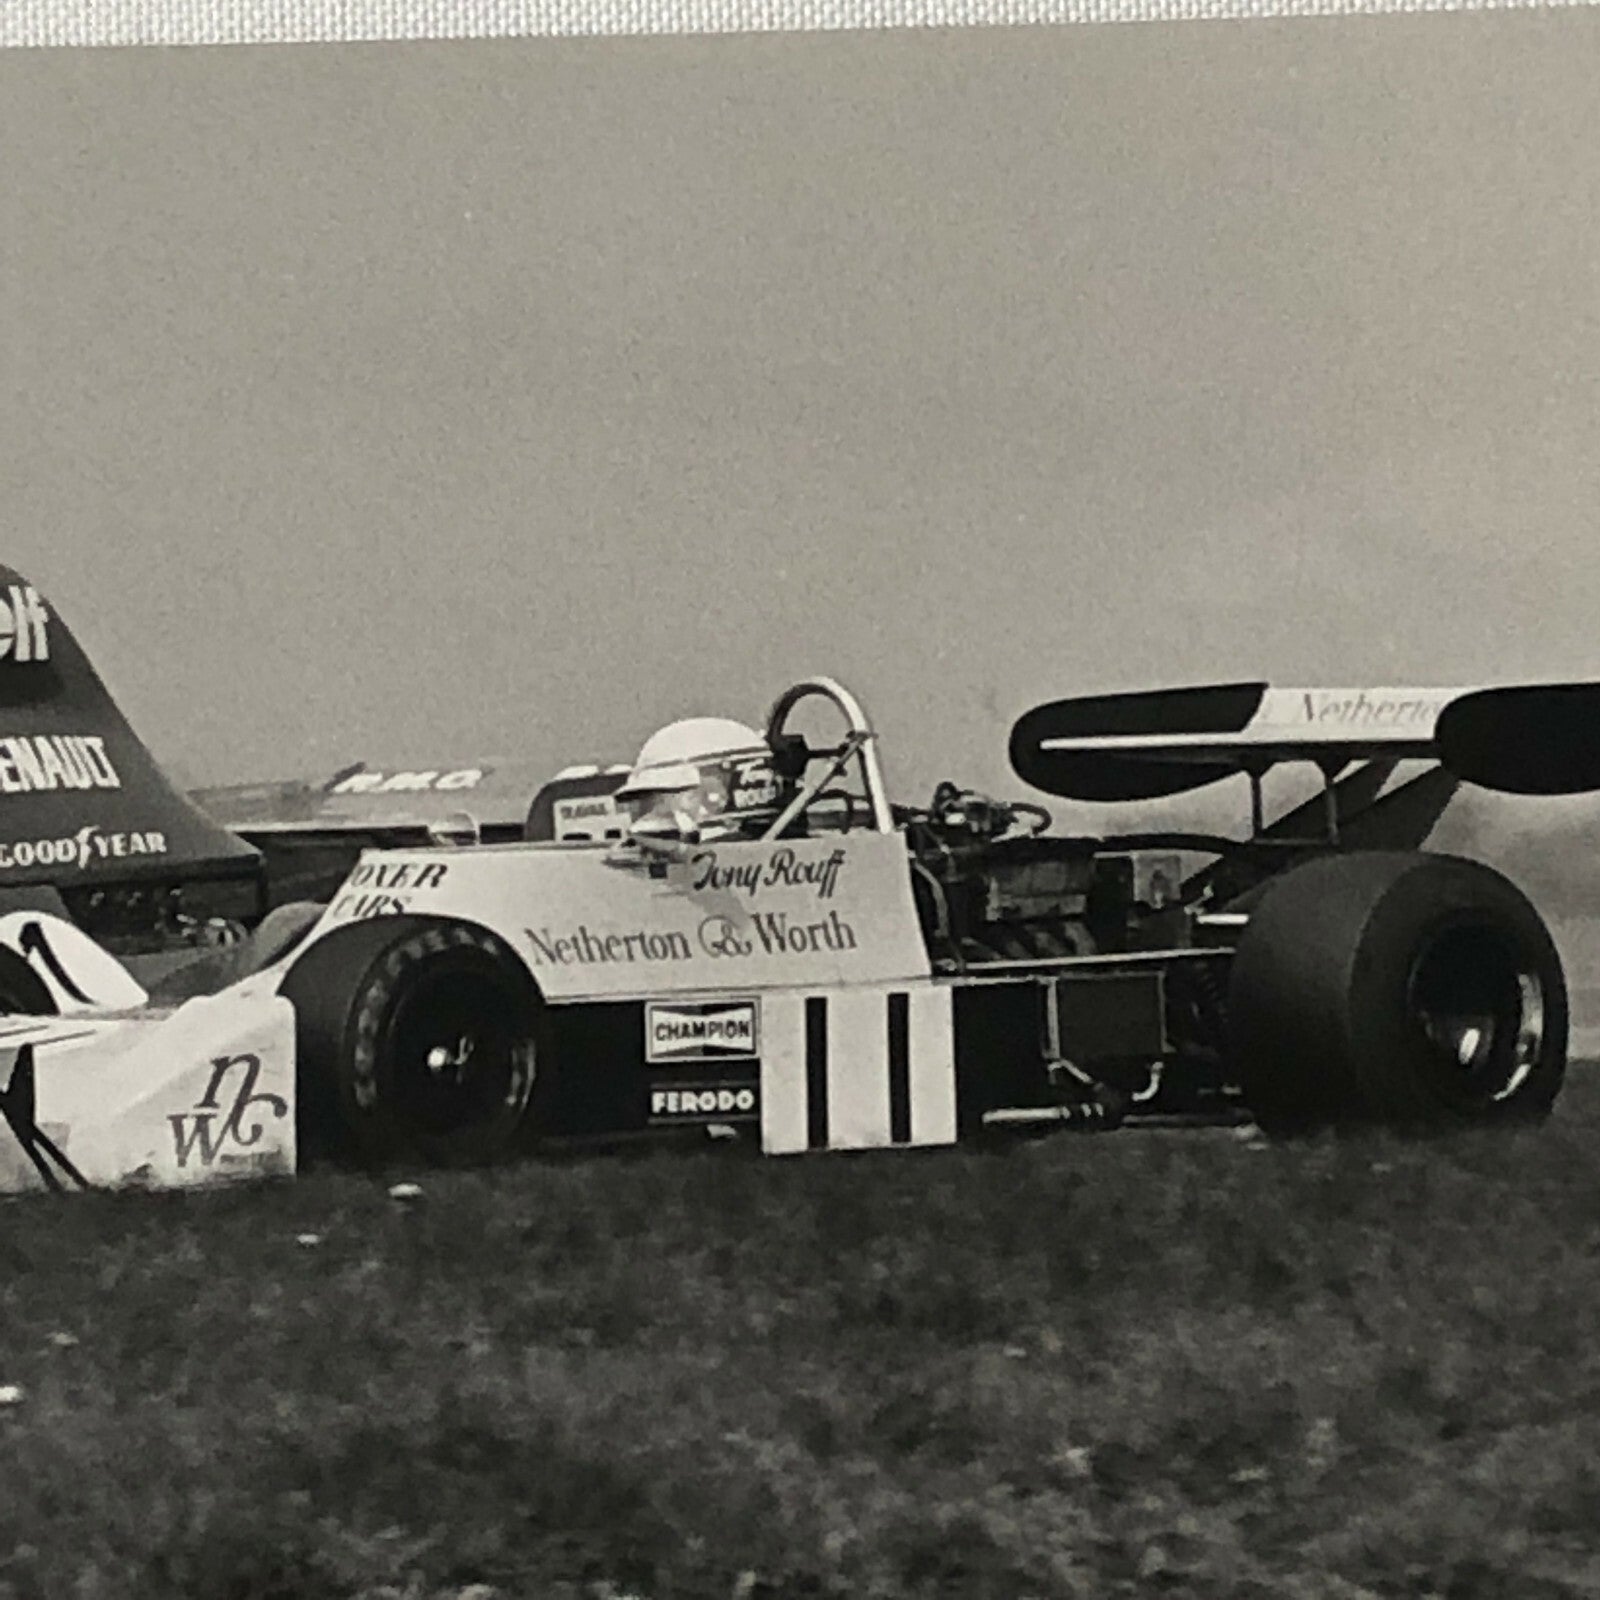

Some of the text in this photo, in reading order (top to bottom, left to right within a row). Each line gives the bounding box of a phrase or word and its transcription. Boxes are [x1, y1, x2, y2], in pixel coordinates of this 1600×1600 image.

[691, 850, 763, 898] Tony
[524, 925, 692, 966] Netherton
[751, 910, 858, 955] Worth
[655, 1020, 750, 1041] CHAMPION
[651, 1088, 755, 1114] FERODO
